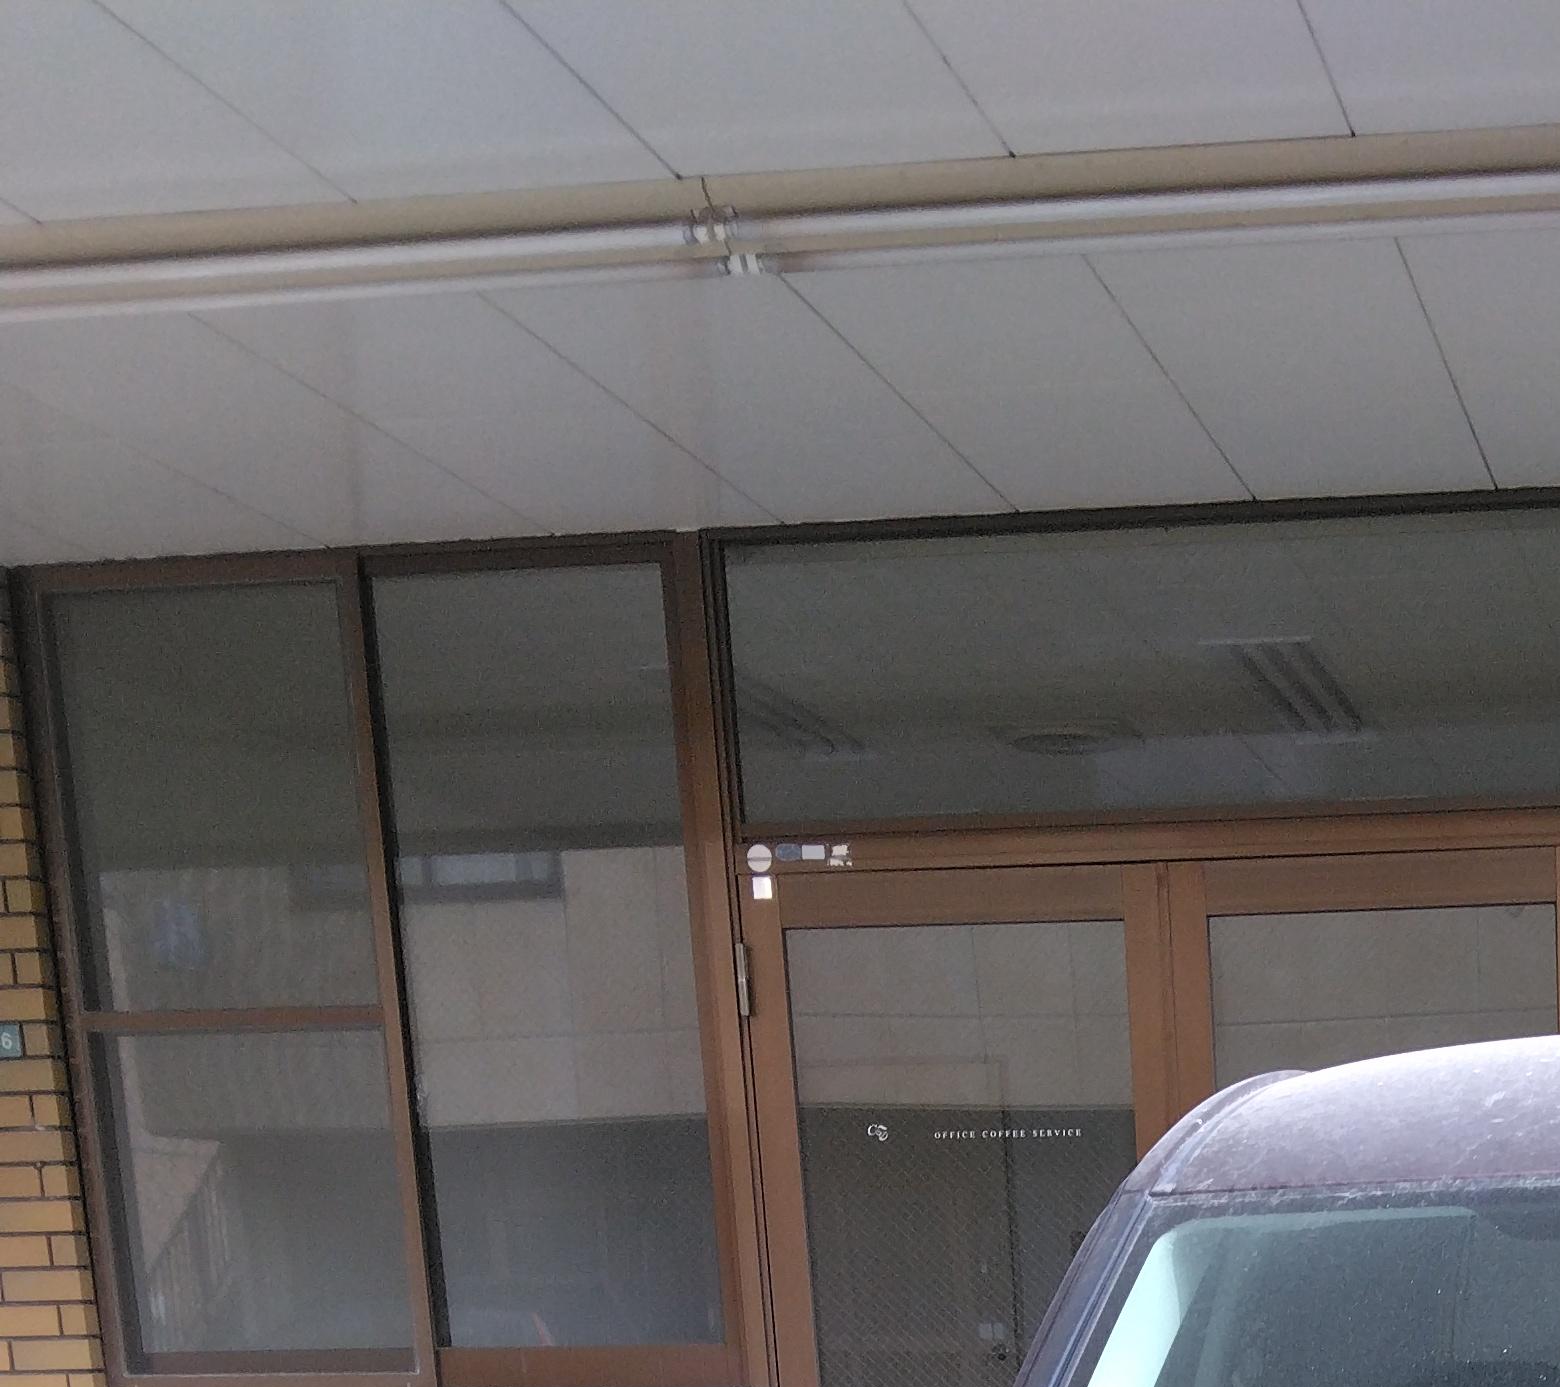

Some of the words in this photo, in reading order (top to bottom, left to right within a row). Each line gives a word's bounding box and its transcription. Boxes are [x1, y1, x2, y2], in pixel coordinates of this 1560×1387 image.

[934, 1129, 976, 1140] OFFICE
[981, 1128, 1027, 1139] COFFEE
[1031, 1127, 1083, 1138] SERVICE
